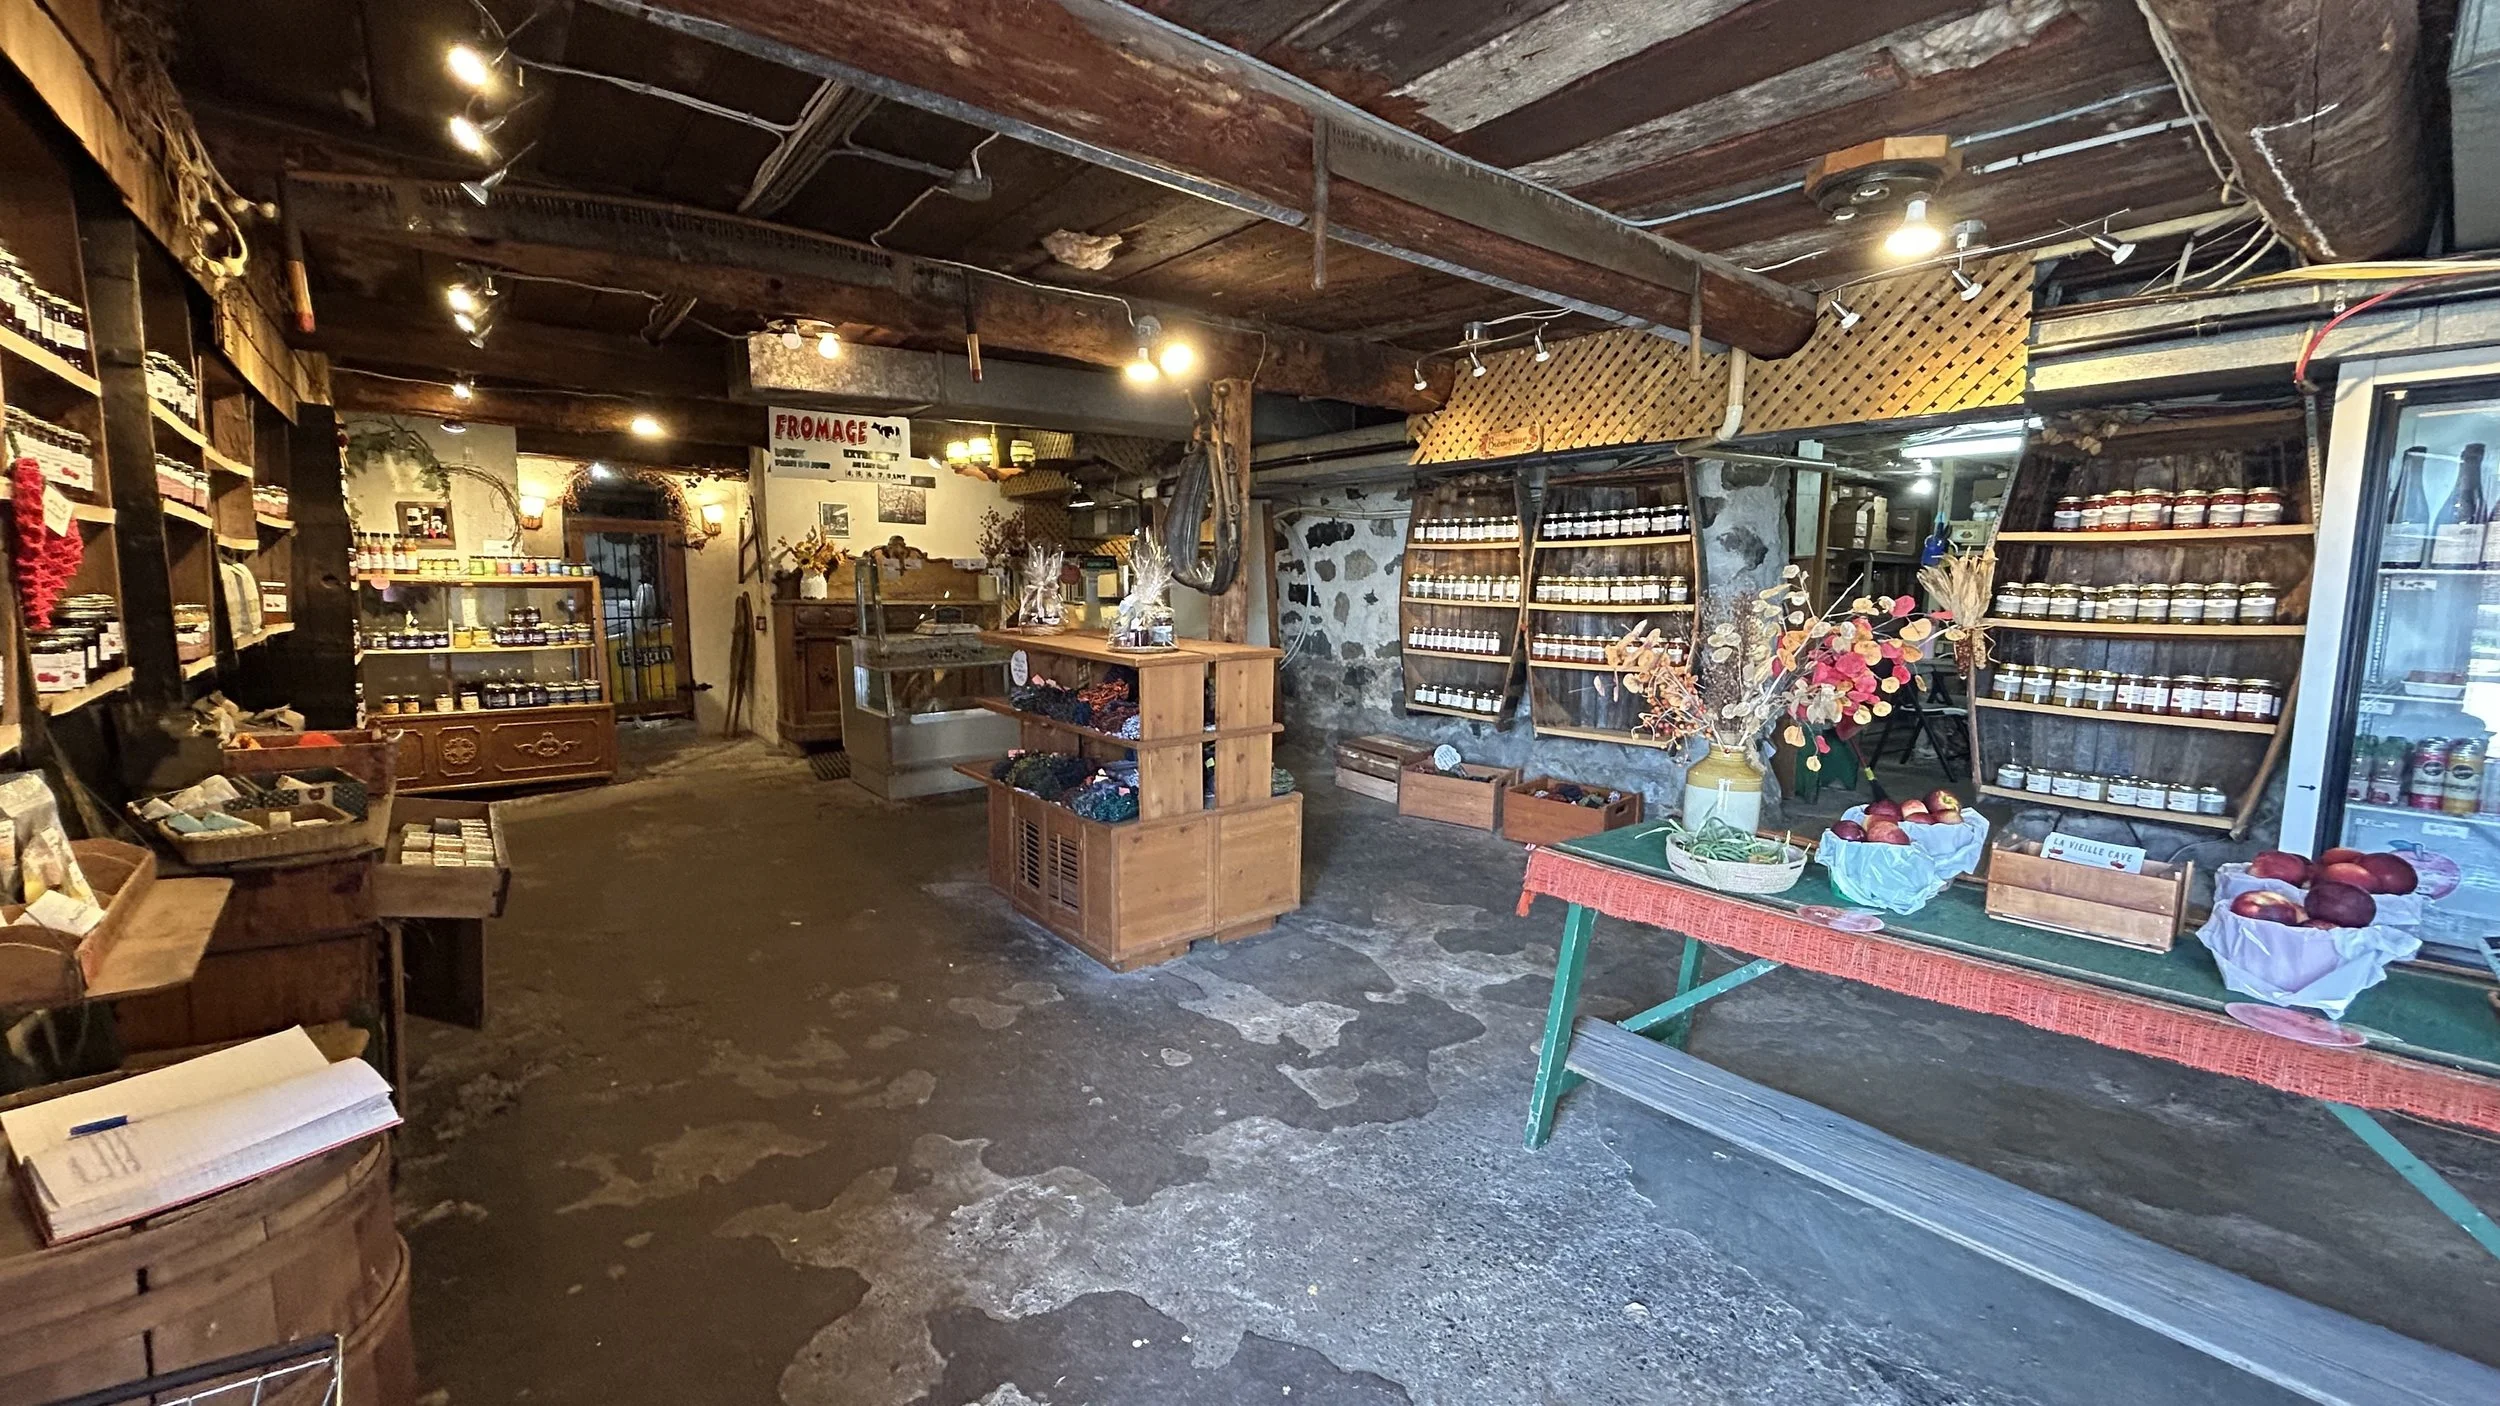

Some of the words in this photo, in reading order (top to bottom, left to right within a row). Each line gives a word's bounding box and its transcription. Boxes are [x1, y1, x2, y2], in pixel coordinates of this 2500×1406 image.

[775, 414, 868, 446] FROMAGE
[2053, 838, 2065, 847] LA
[2069, 841, 2104, 856] VIEILLE
[2107, 850, 2133, 863] CAVE
